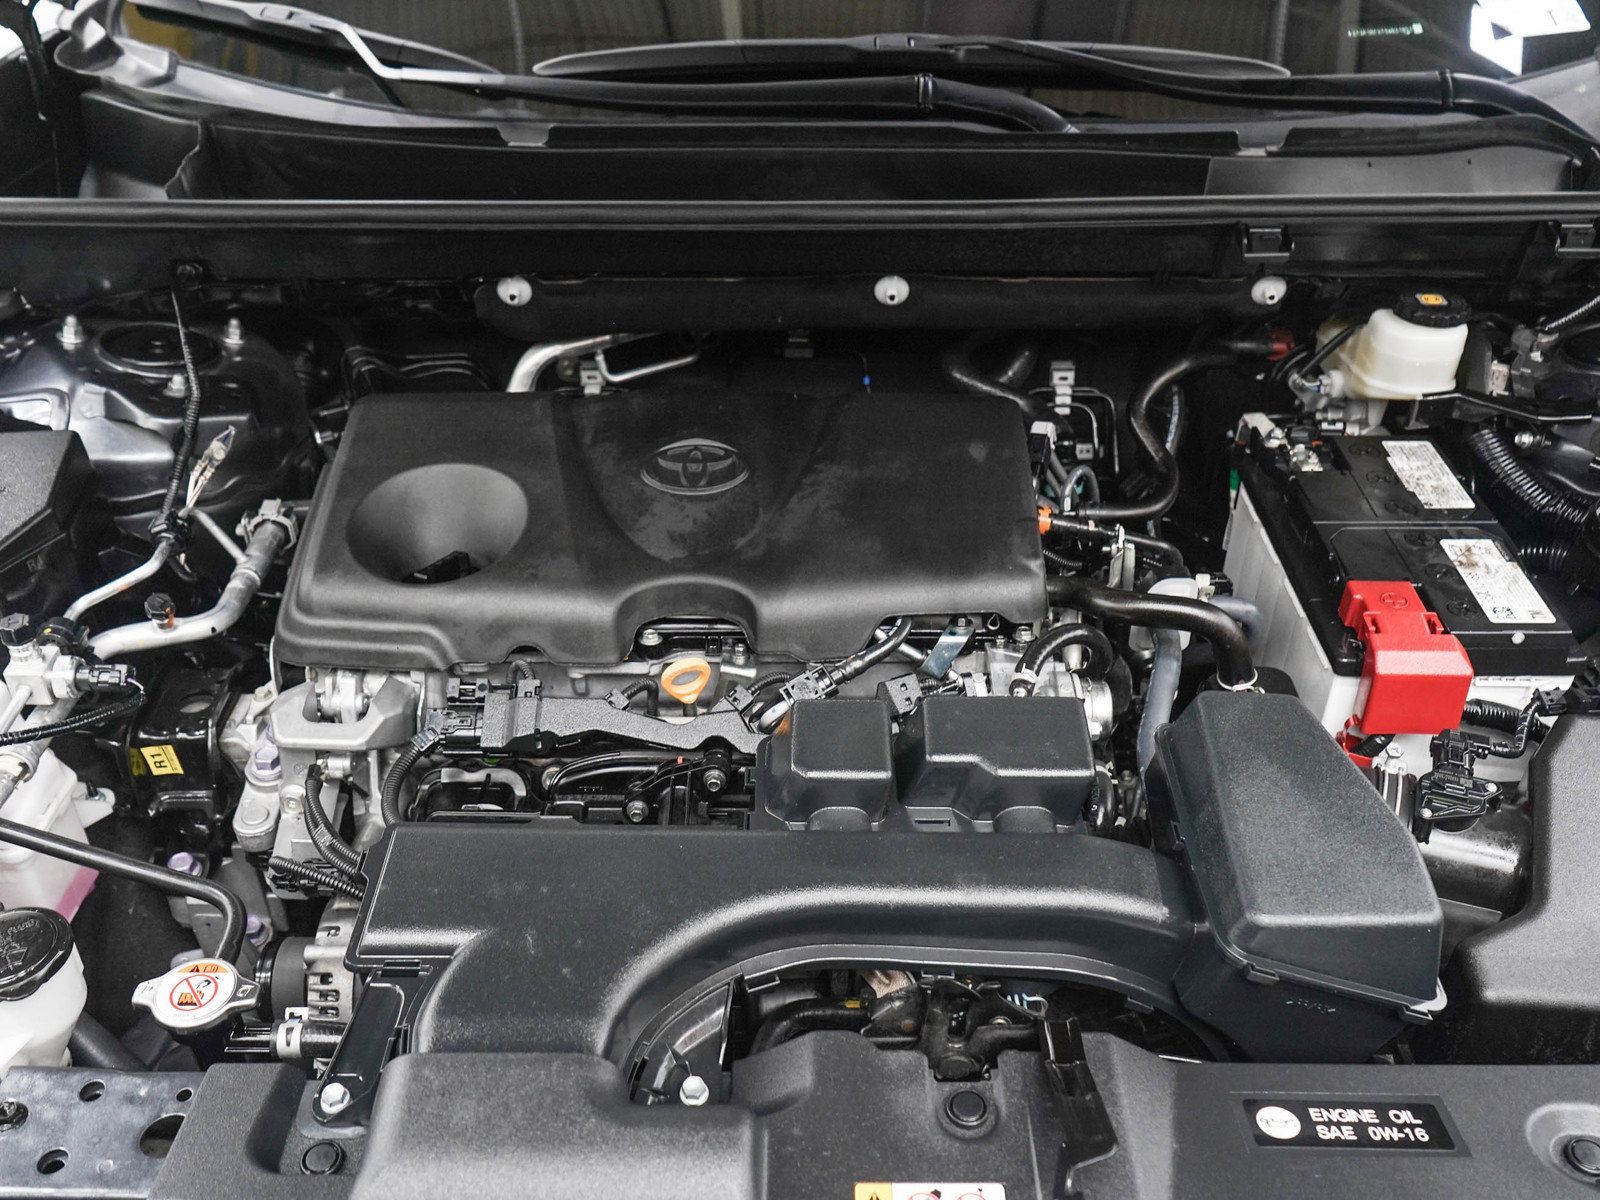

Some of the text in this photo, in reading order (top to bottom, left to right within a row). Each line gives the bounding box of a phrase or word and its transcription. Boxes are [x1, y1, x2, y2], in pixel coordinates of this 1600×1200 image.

[150, 753, 168, 769] R1
[1307, 1107, 1423, 1125] ENGINE OIL
[1315, 1124, 1430, 1143] SAE 0W-16
